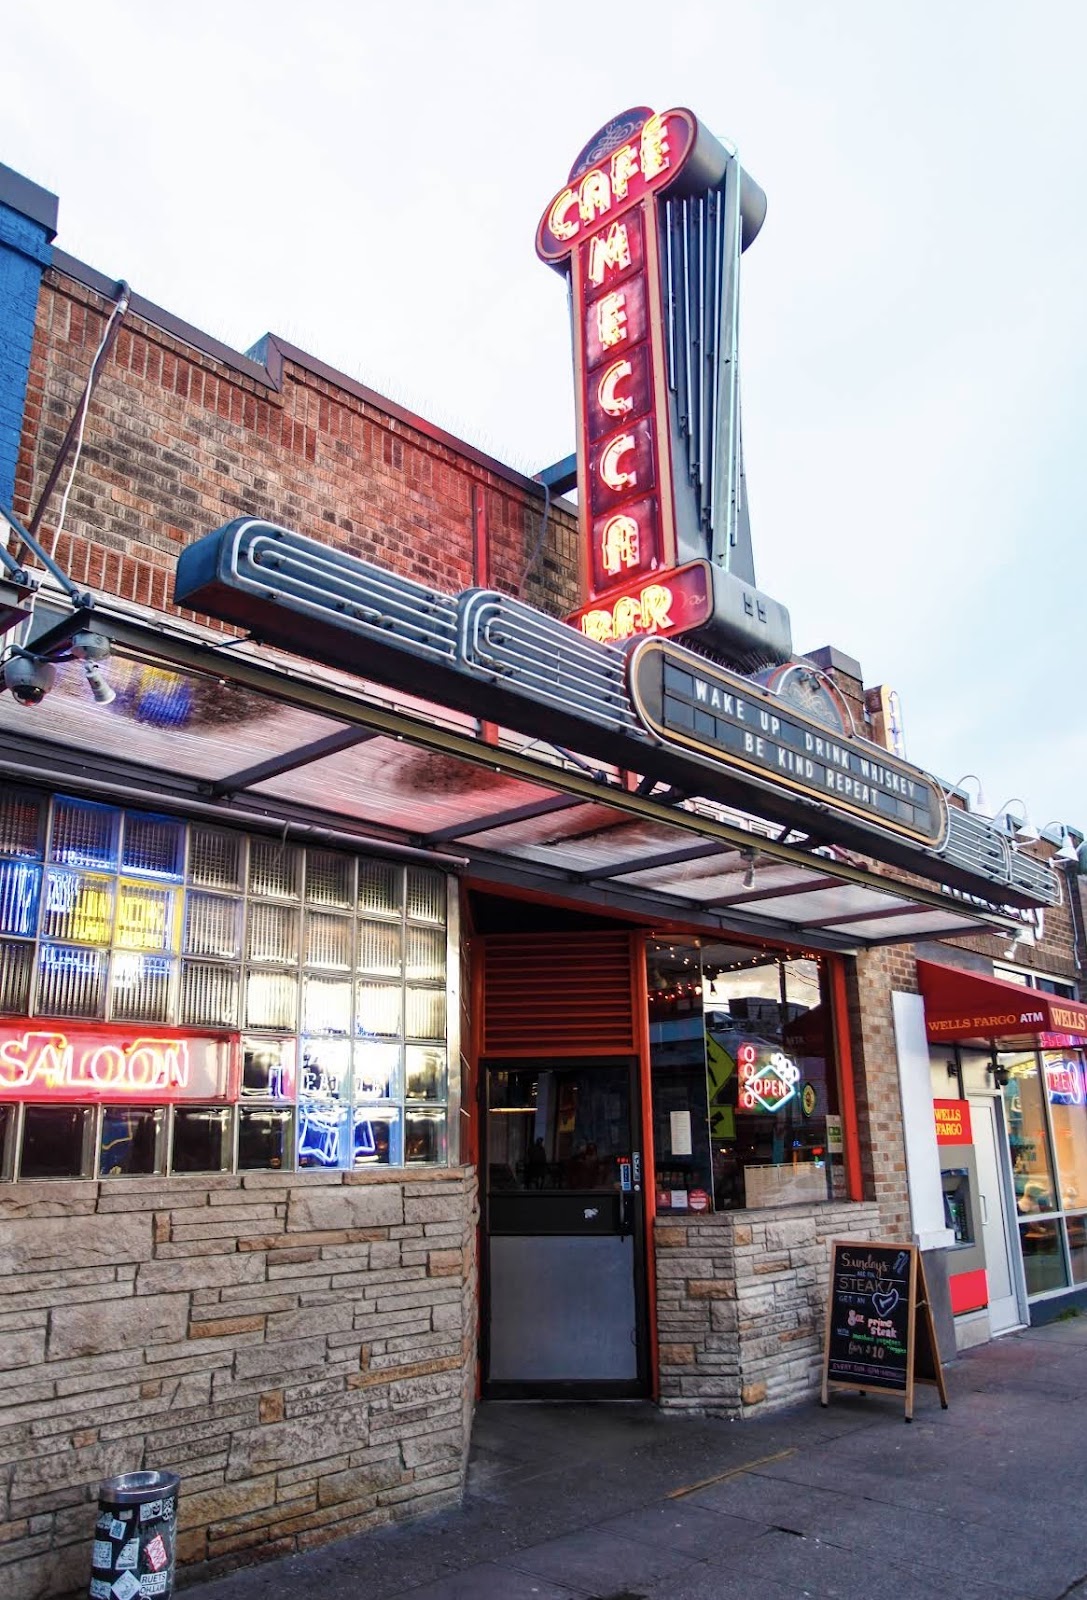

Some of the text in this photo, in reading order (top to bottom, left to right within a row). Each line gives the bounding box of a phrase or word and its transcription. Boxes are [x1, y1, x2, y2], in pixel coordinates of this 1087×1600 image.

[588, 222, 640, 576] MECCA
[581, 584, 674, 642] BAR
[695, 679, 915, 797] WAKE UP DRINK WHISKEY
[745, 732, 879, 806] BE KIND REPEAT
[928, 1012, 1043, 1031] WELLS FARGO ATM
[1051, 1007, 1086, 1030] WELLS
[0, 1032, 188, 1088] SALOON
[753, 1079, 787, 1097] OPEN
[934, 1108, 962, 1122] WELLS
[936, 1122, 963, 1136] FARGO
[841, 1252, 889, 1279] Sundays
[870, 1326, 897, 1338] steak
